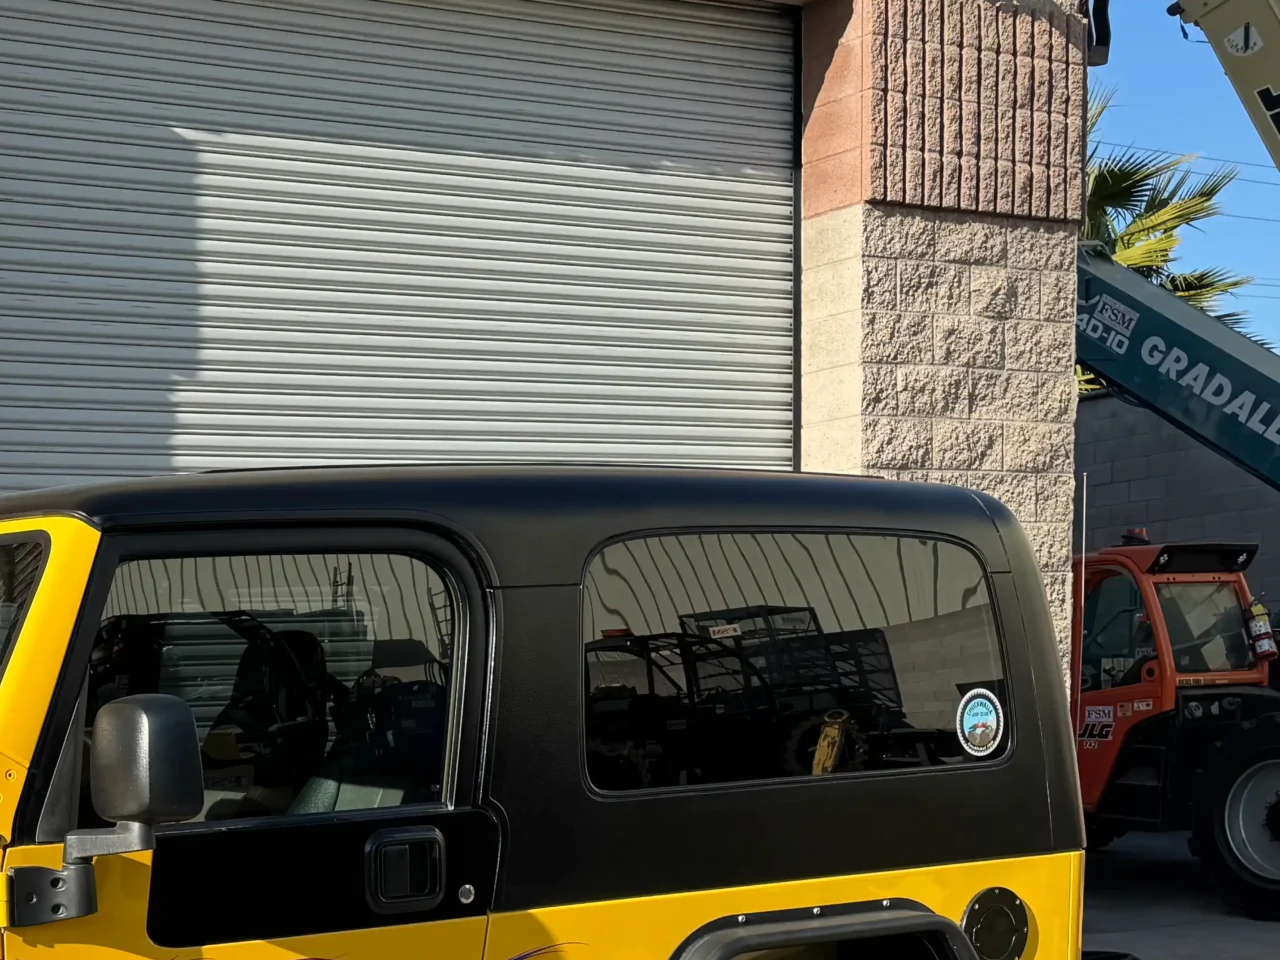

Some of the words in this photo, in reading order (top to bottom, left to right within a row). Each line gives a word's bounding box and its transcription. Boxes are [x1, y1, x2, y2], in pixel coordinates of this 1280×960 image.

[1098, 301, 1134, 330] FSM
[1141, 336, 1280, 445] GRADALL
[1086, 709, 1112, 719] FSM
[1077, 723, 1114, 740] JLG
[1083, 741, 1098, 749] 742
